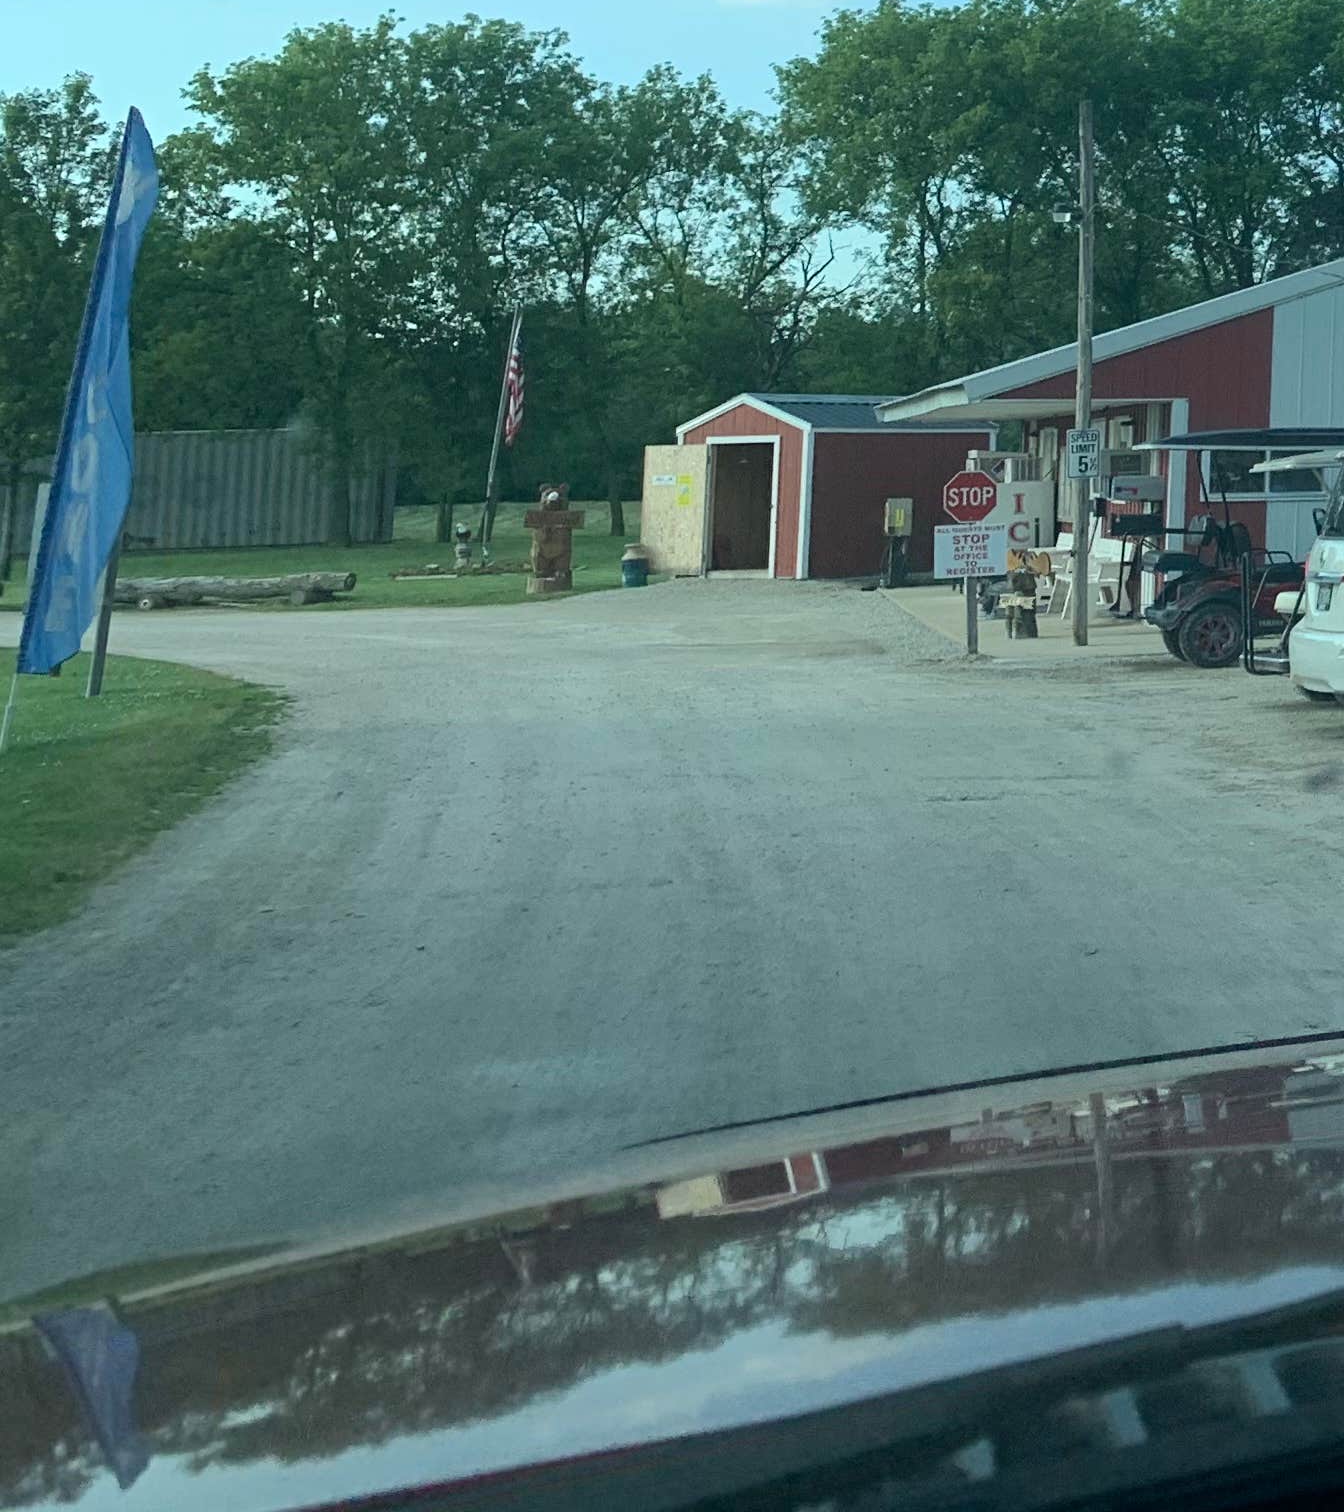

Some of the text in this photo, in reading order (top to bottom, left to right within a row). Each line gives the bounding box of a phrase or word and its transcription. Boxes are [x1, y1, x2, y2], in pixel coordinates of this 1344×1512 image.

[1071, 432, 1097, 443] SPEED
[1071, 443, 1096, 454] LIMIT
[948, 487, 994, 507] STOP
[952, 534, 990, 544] STOP
[965, 560, 978, 568] TO
[946, 567, 995, 575] REGISTER
